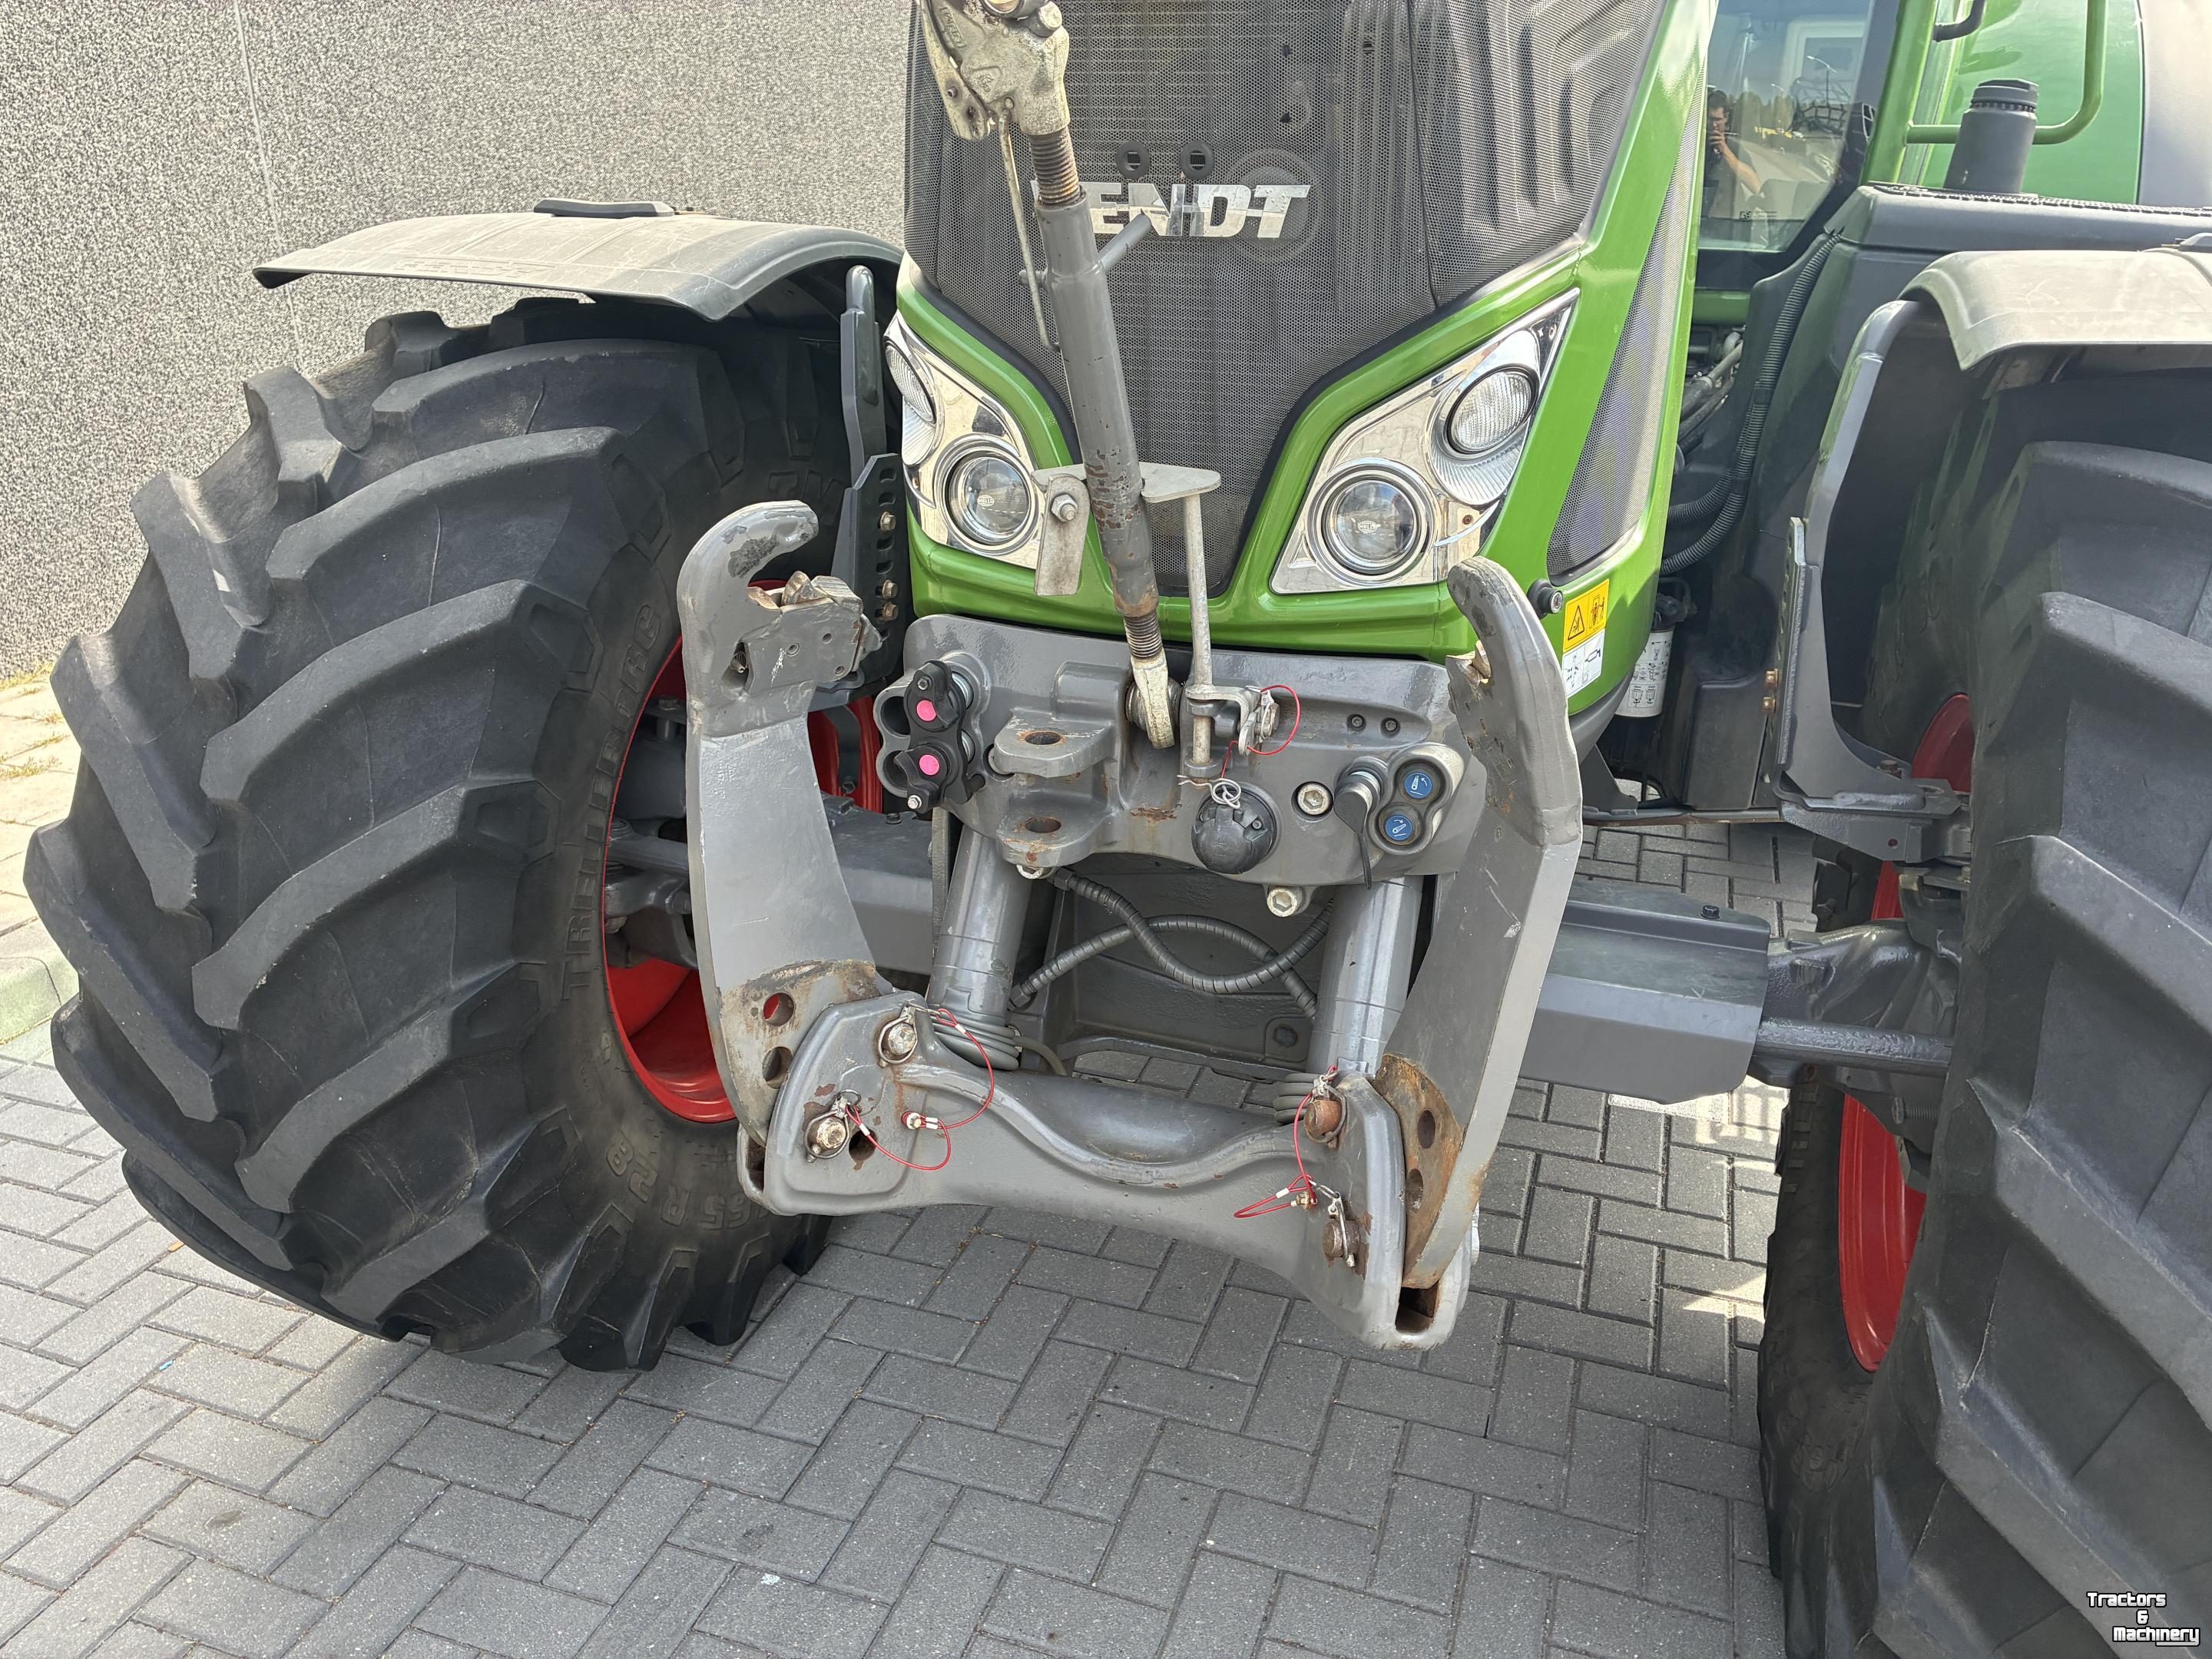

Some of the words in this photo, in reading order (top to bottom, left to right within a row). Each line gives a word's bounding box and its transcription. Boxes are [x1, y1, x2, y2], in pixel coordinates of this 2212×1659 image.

[1031, 180, 1312, 238] ENDT
[561, 603, 661, 1001] TRELLEBORG
[606, 1132, 658, 1204] 28
[661, 1185, 690, 1227] R
